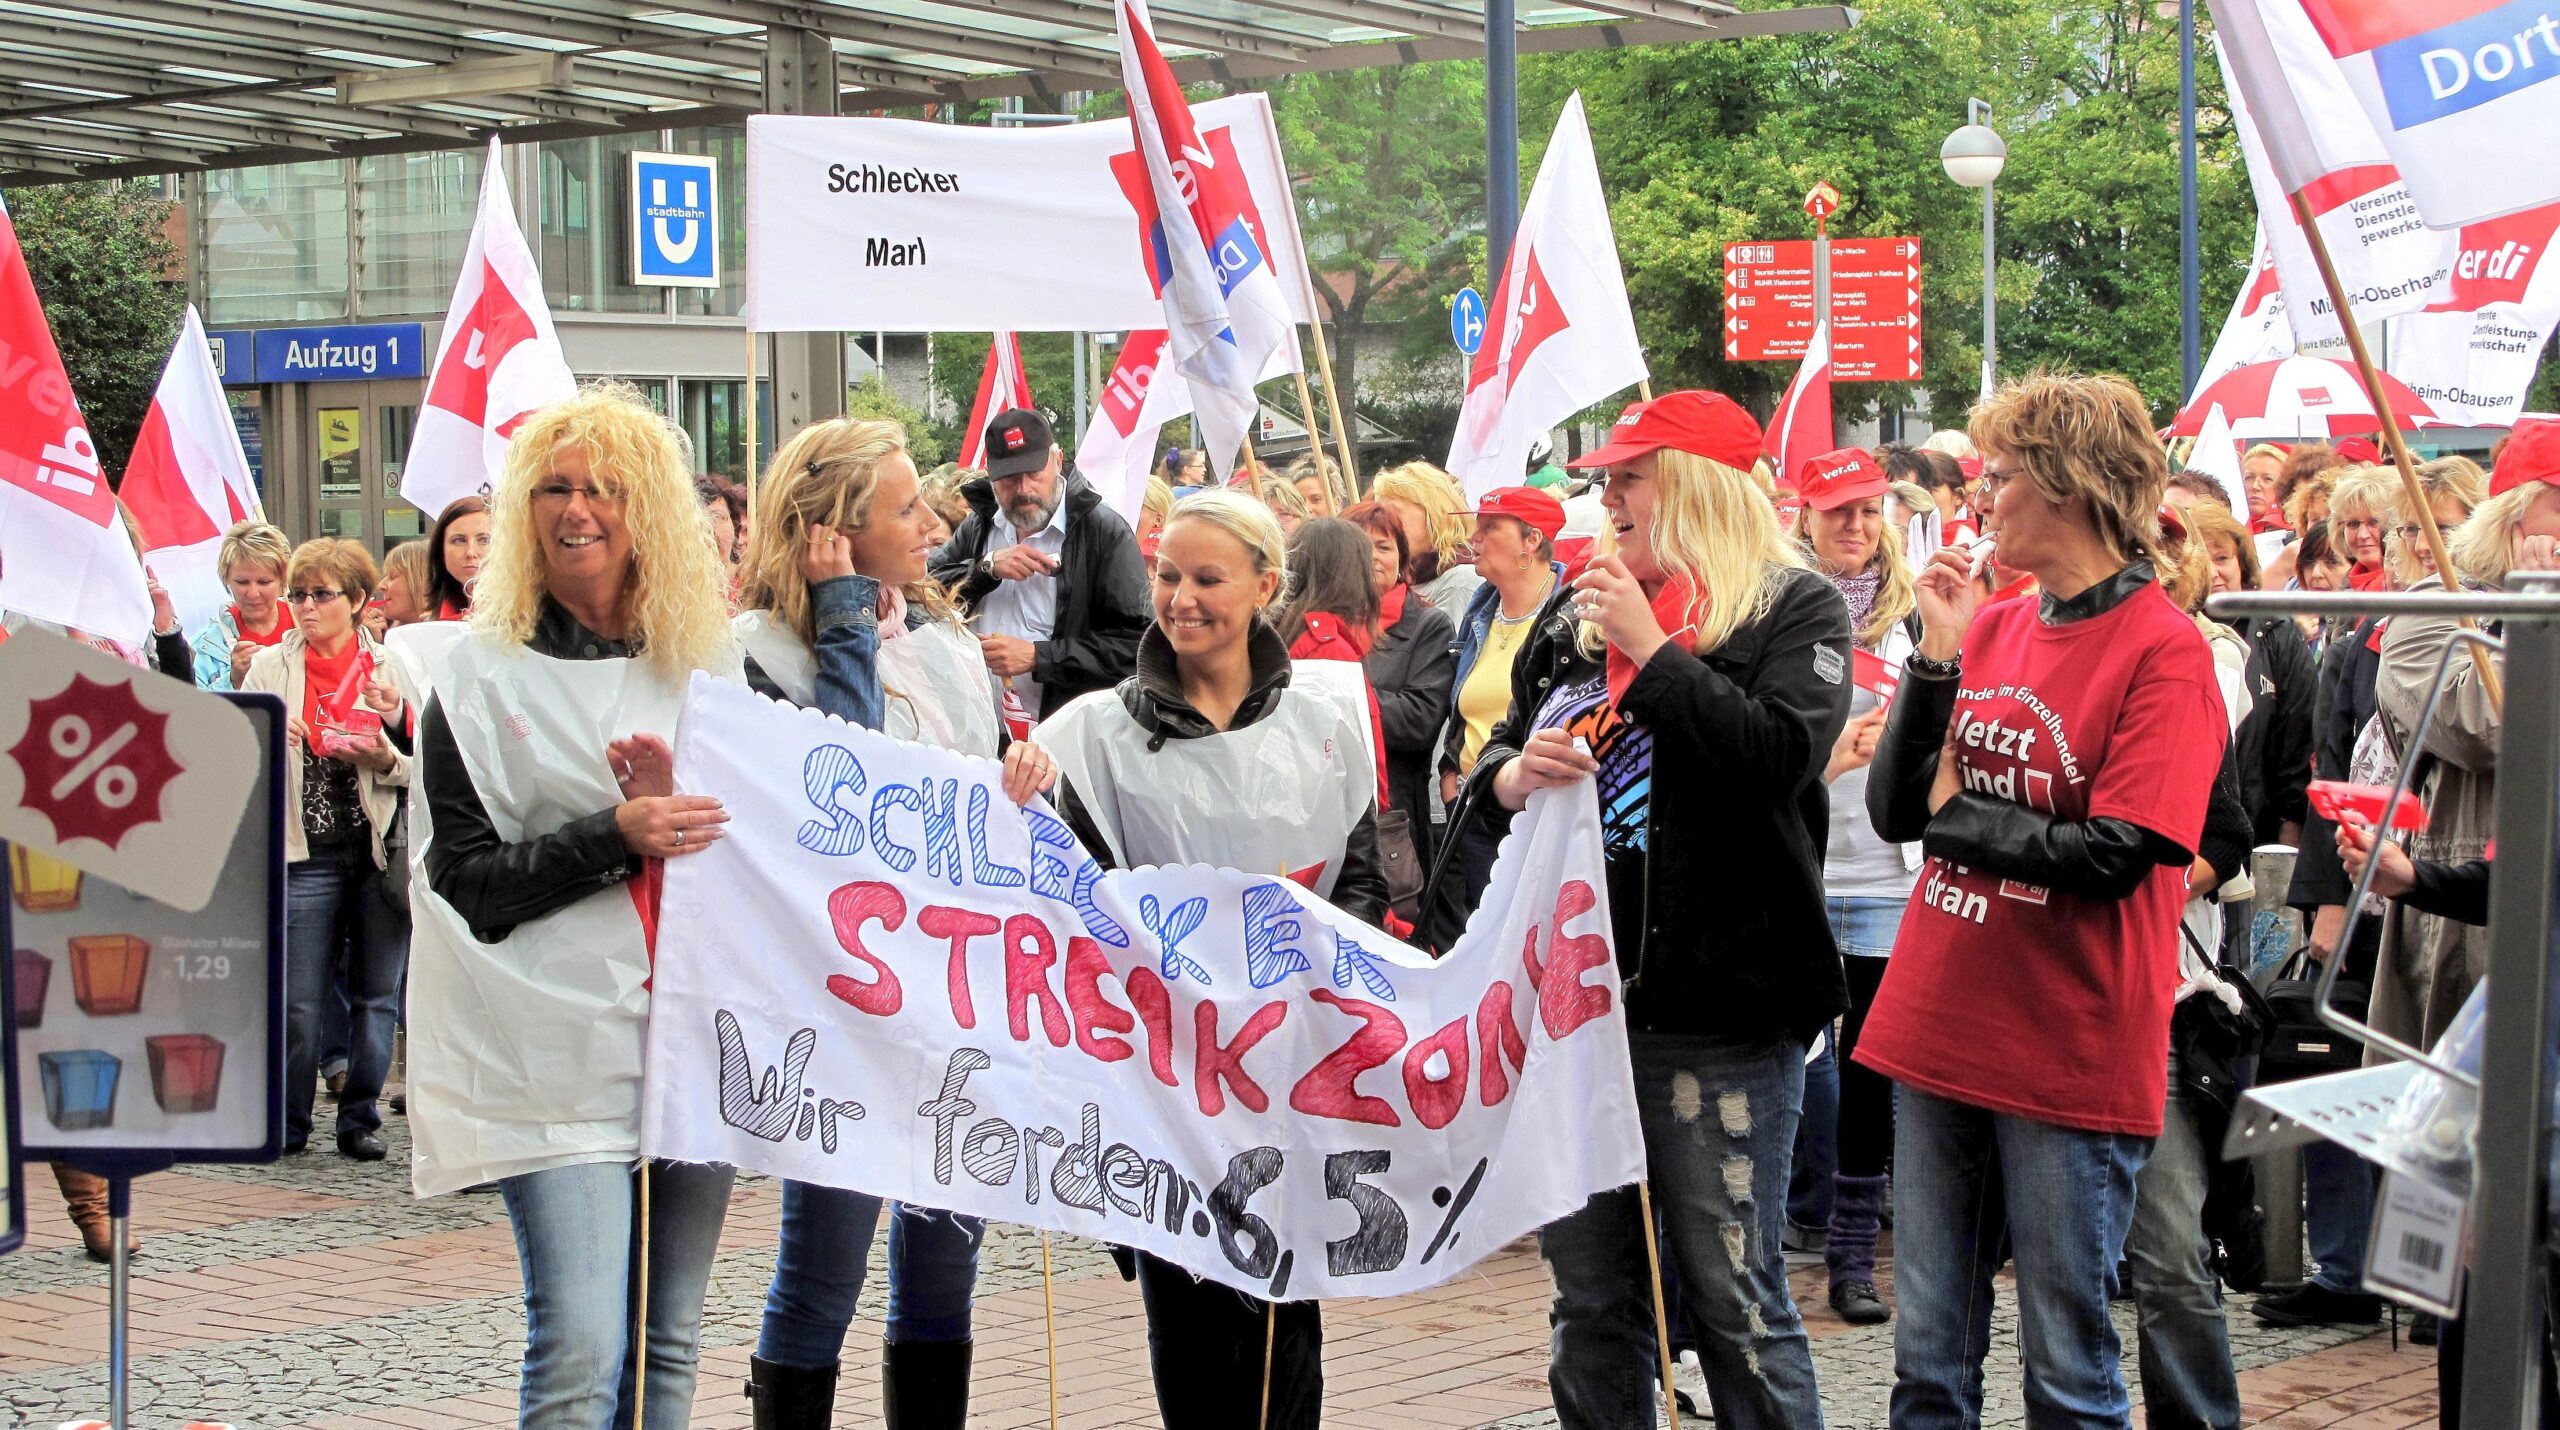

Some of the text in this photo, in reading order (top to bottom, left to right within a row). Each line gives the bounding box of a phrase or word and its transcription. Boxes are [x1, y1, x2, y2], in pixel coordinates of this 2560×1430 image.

[828, 164, 960, 193] Schlecker
[646, 206, 705, 219] stadtbahn
[865, 237, 926, 267] Marl
[1833, 271, 1873, 279] Friedensplatz
[285, 337, 398, 374] Aufzug 1
[1822, 461, 1861, 480] ver.di
[1998, 682, 2014, 697] im
[2014, 685, 2086, 785] Einzelhandel
[1957, 756, 2016, 800] ind
[1924, 870, 1989, 924] dran
[173, 954, 231, 982] 1,29
[715, 1009, 866, 1154] Wir
